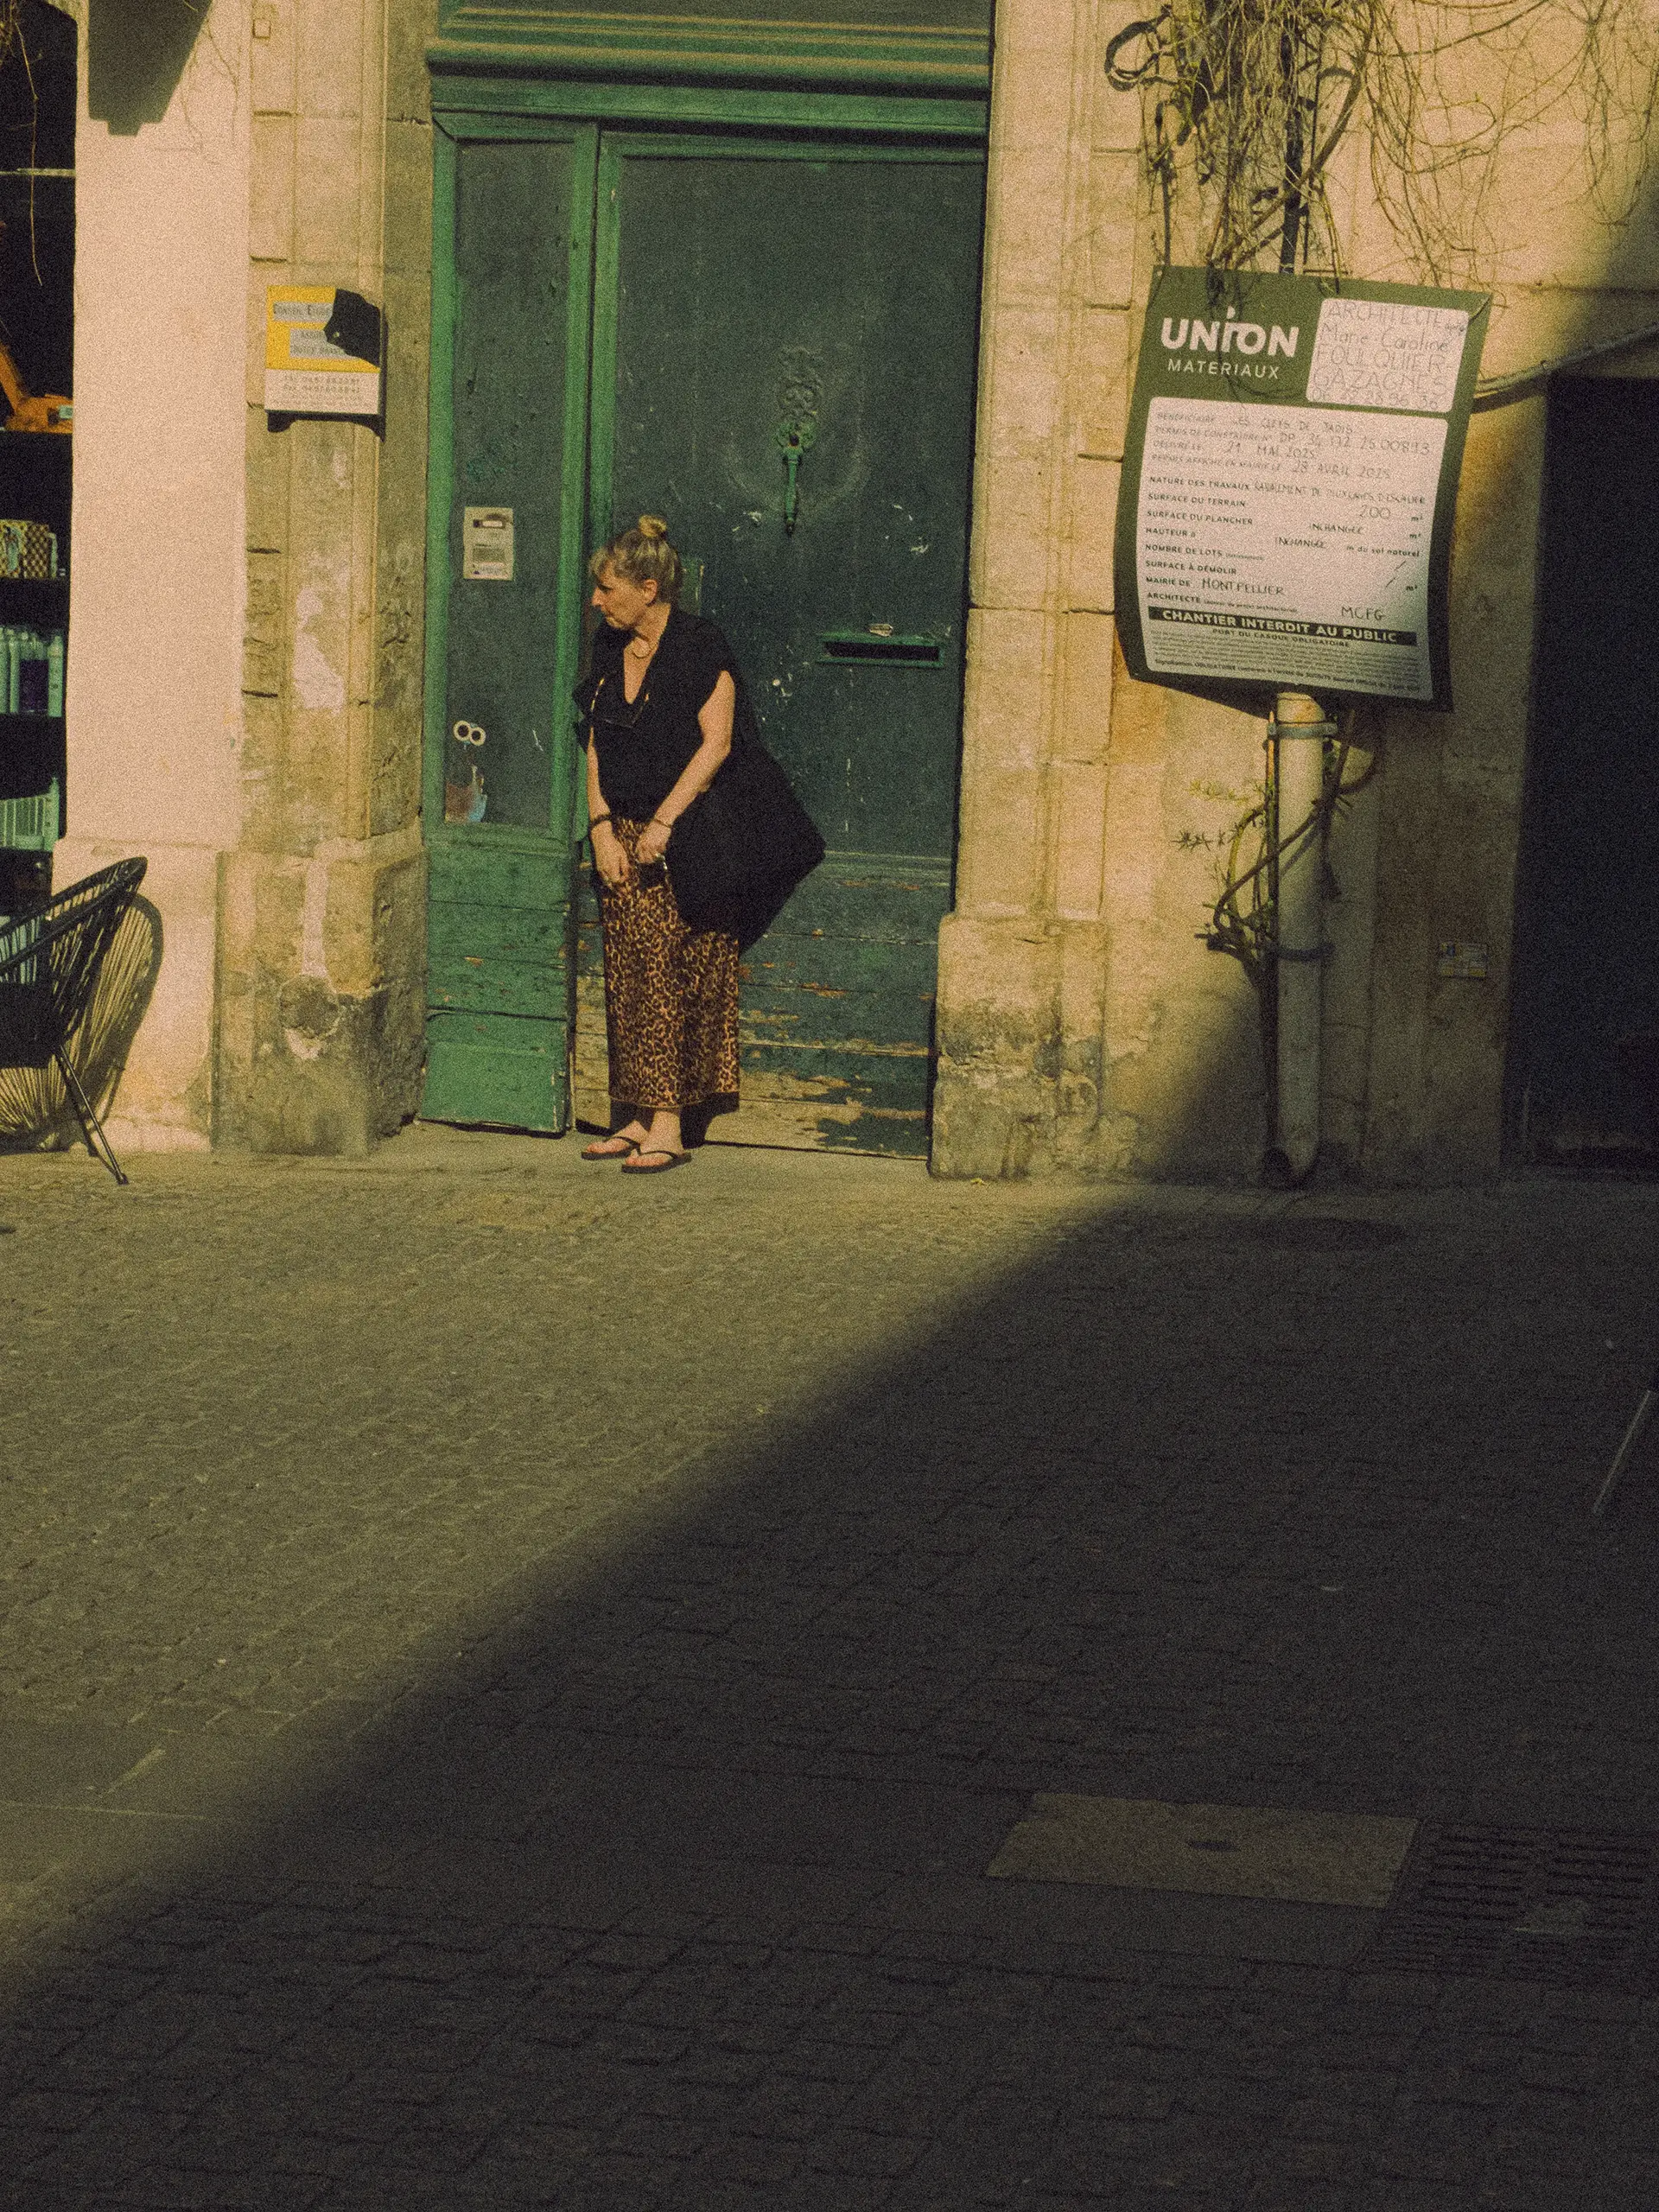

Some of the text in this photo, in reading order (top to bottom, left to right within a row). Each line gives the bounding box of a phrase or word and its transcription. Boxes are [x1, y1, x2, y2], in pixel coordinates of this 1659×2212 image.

[1325, 301, 1442, 329] ARCHITECTE
[1167, 358, 1280, 380] MATERIAUX
[1154, 425, 1187, 436] PERMIS
[1148, 476, 1250, 492] NATURE DES TRAVAUX
[1147, 493, 1246, 508] SURFACE DU TERRAIN
[1146, 510, 1187, 520] SURFACE
[1205, 515, 1254, 525] PLANCHER
[1359, 505, 1392, 520] 200
[1145, 527, 1188, 537] HAUTEUR
[1145, 543, 1183, 555] NOMBRE
[1185, 547, 1197, 556] DE
[1198, 548, 1224, 558] LOTS
[1357, 545, 1369, 554] du
[1371, 547, 1384, 556] sol
[1386, 549, 1421, 559] naturel
[1145, 560, 1185, 570] SURFACE
[1197, 563, 1237, 575] DÉMOLIR
[1145, 575, 1191, 588] MAIRIE DE
[1147, 592, 1201, 604] ARCHITECTE
[1162, 609, 1398, 643] CHANTIER INTERDIT AU PUBLIC
[1211, 628, 1351, 648] PORT DU CASQUE OBLIGATOIRE
